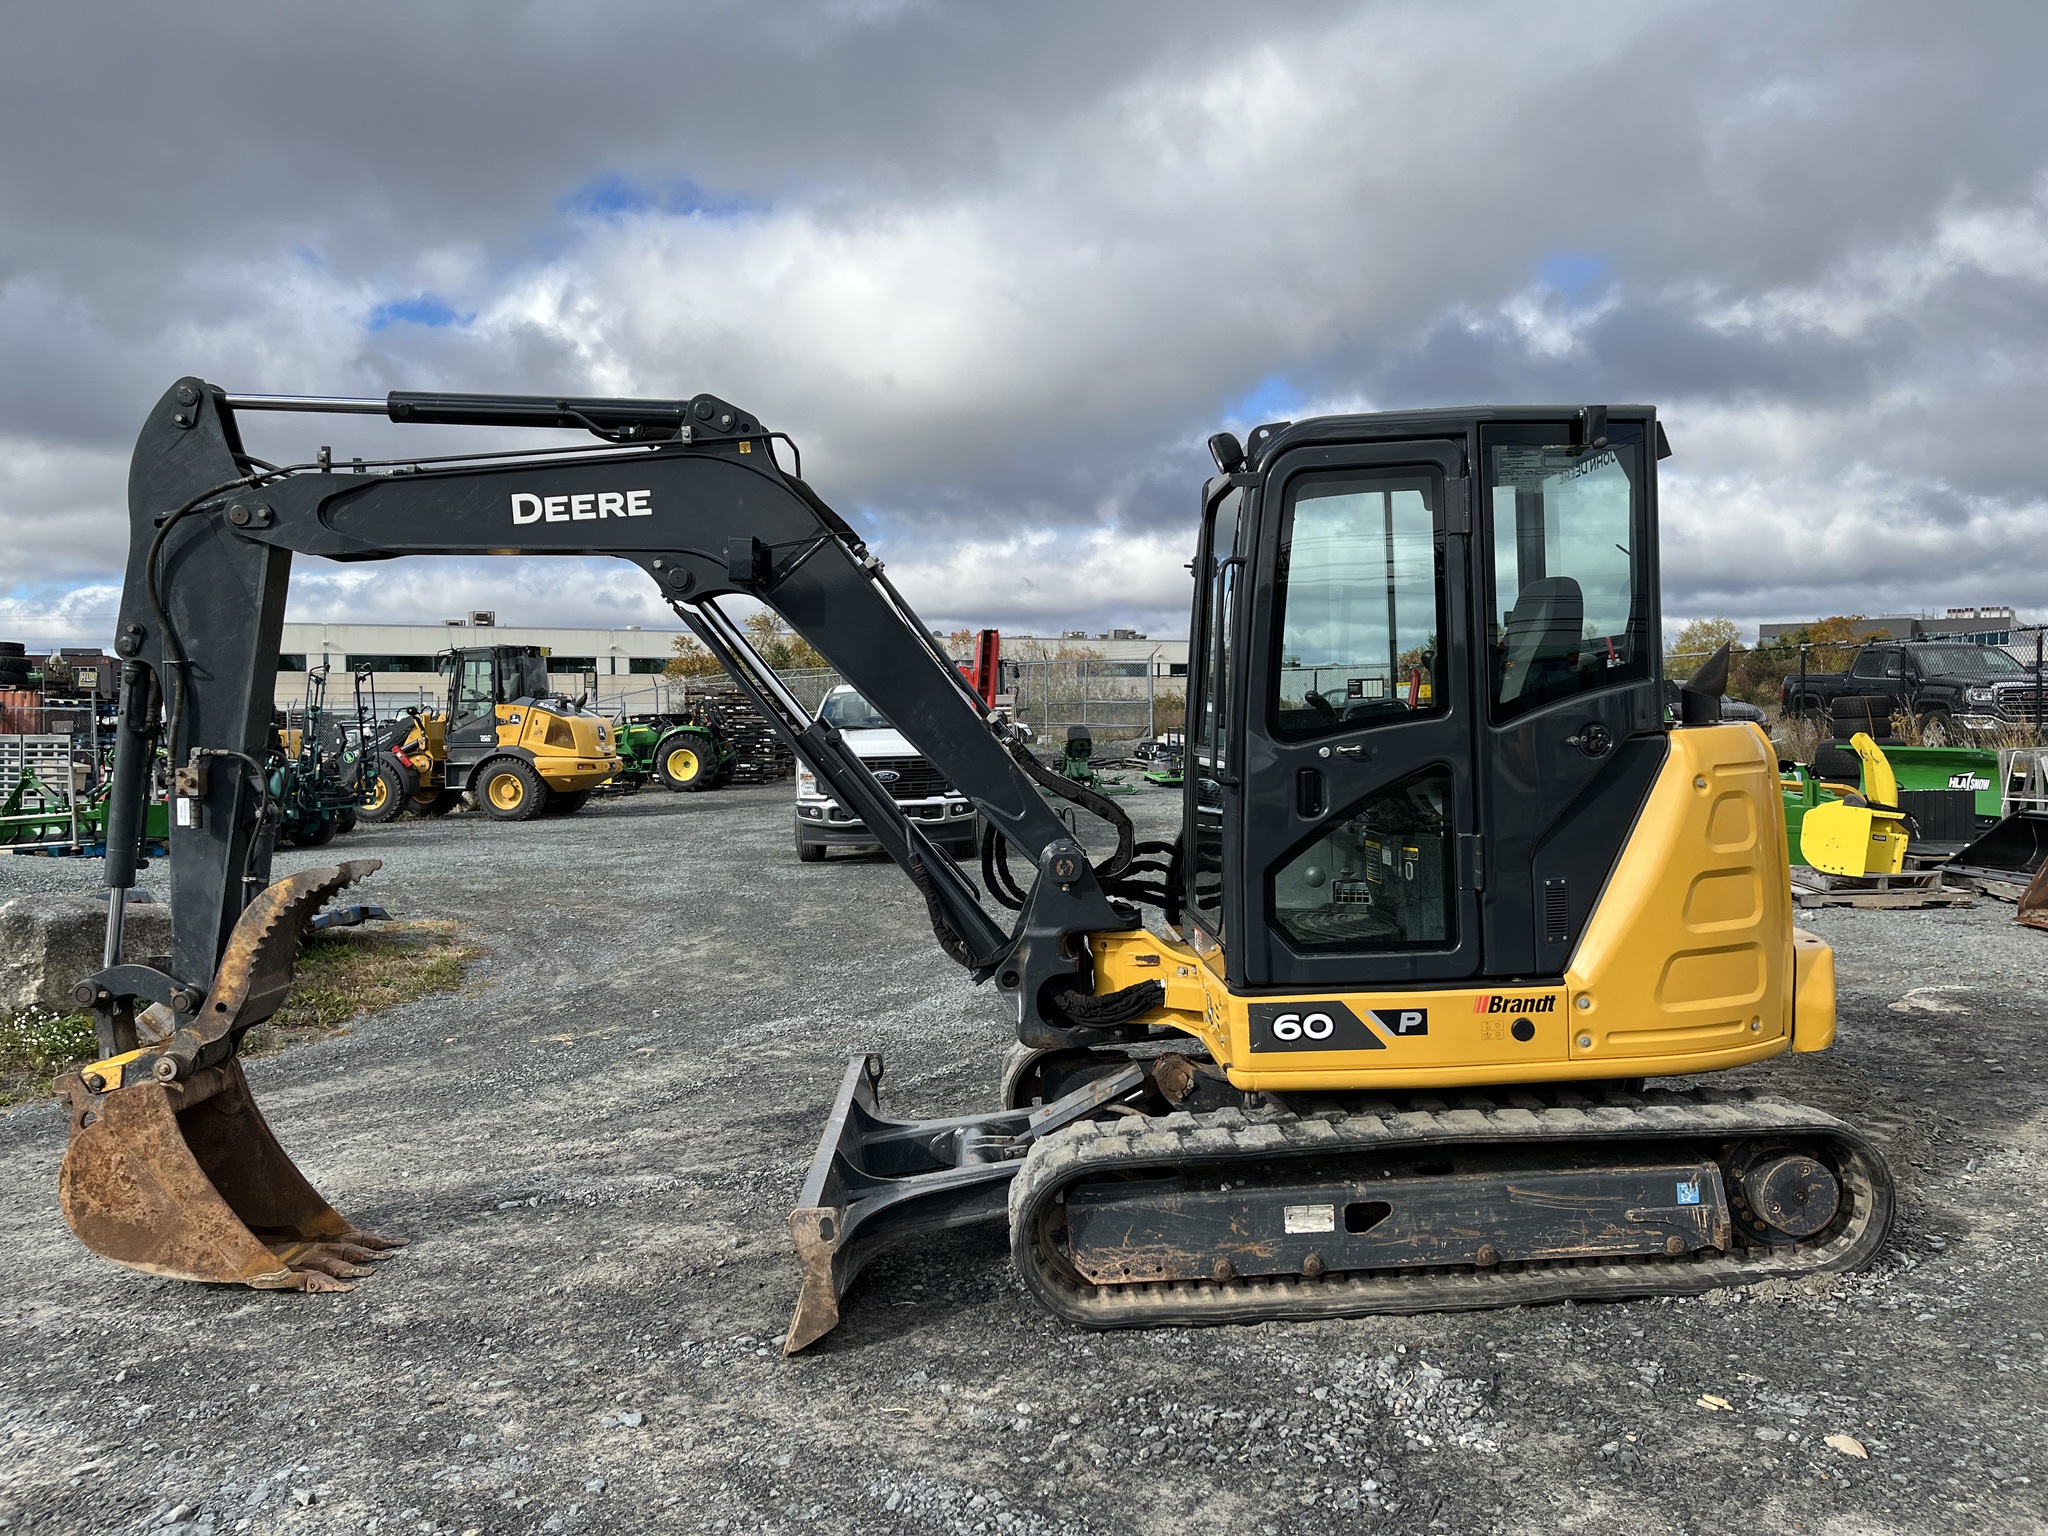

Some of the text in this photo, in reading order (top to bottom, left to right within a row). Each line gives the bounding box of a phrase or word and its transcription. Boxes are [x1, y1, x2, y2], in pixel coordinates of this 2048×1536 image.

[511, 490, 652, 524] DEERE
[80, 673, 96, 682] HLA
[1948, 776, 1991, 790] HLA SNOW
[1488, 995, 1556, 1013] Brandt
[1273, 1012, 1422, 1040] 60 P
